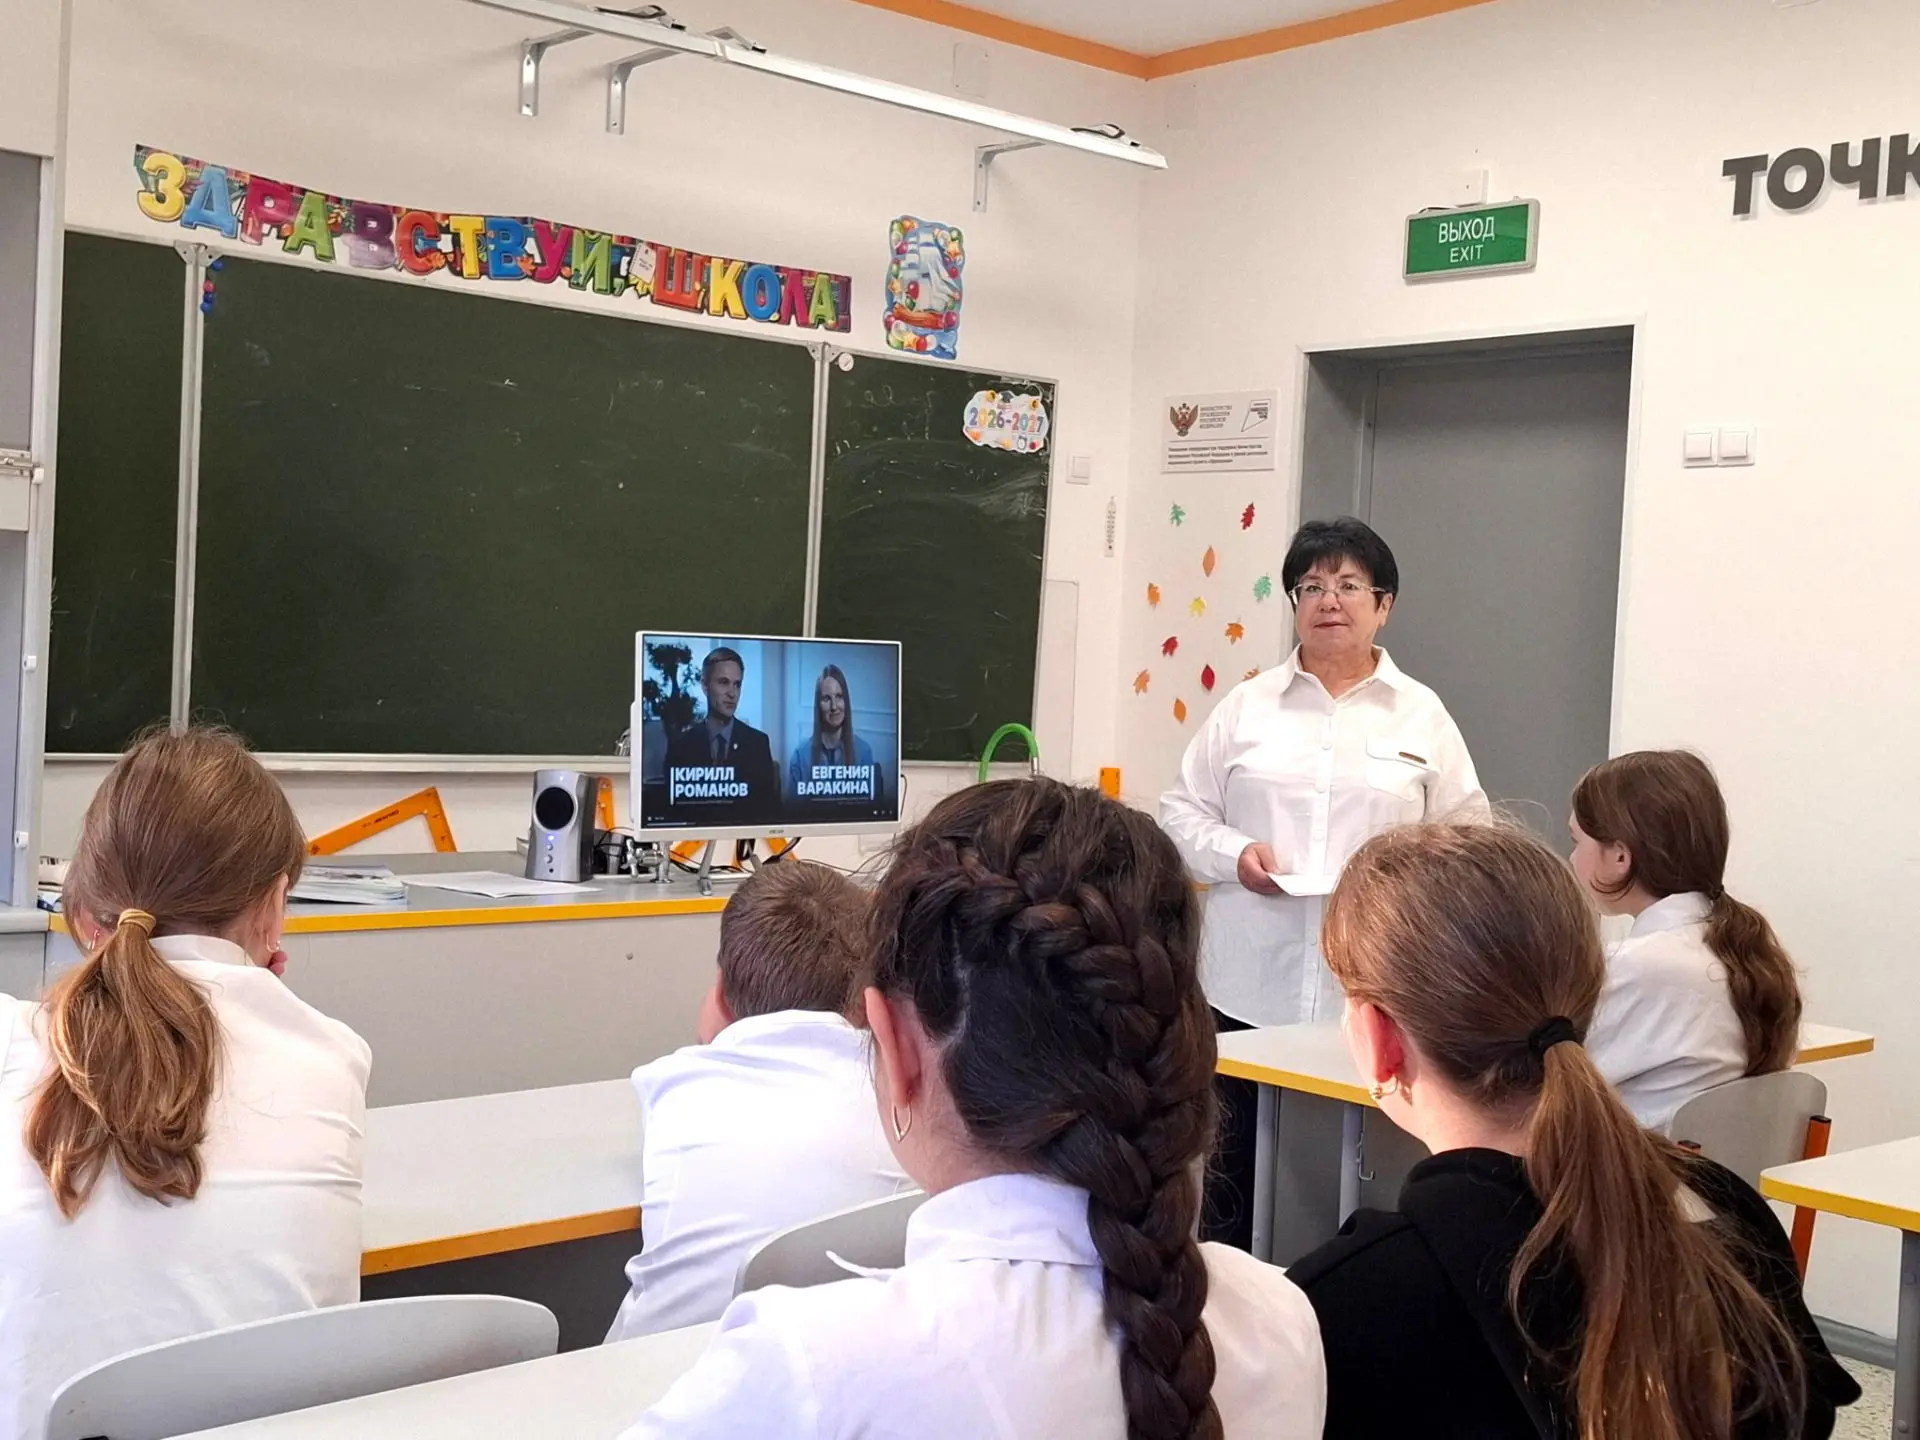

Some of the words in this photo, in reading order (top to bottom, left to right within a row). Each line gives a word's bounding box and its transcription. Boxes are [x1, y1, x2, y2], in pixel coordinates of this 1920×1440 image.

[1438, 216, 1495, 243] ВЫХОД
[1450, 244, 1484, 263] EXIT
[653, 246, 851, 333] ШКОЛА!
[969, 406, 1044, 433] 2026-2027
[675, 767, 735, 781] КИРИЛЛ
[812, 766, 870, 780] ЕВГЕНИЯ
[675, 783, 749, 798] РОМАНОВ
[797, 781, 869, 795] ВАРАКИНА
